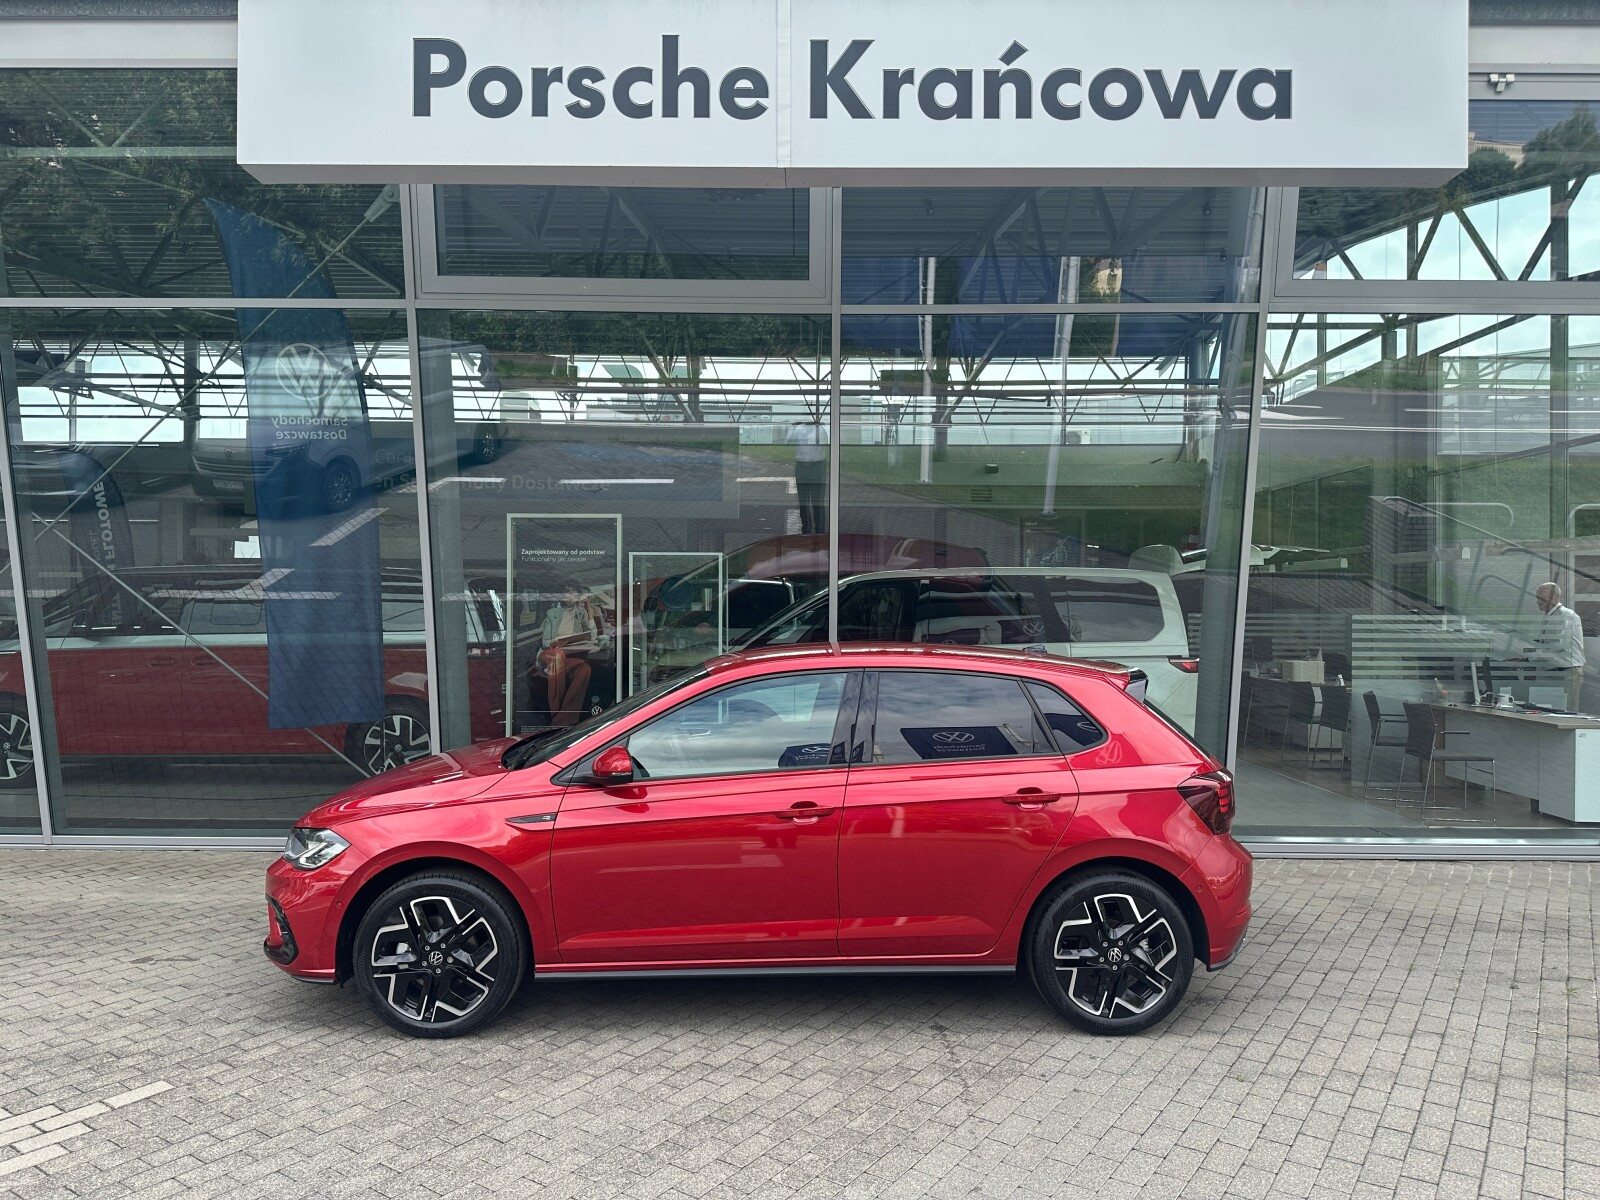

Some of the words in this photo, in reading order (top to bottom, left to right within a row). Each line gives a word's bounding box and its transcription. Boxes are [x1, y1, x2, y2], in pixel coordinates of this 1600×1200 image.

[412, 34, 770, 121] Porsche
[809, 39, 1293, 121] Krańcowa
[521, 548, 569, 556] Zaprojektowany
[579, 548, 606, 556] podstaw
